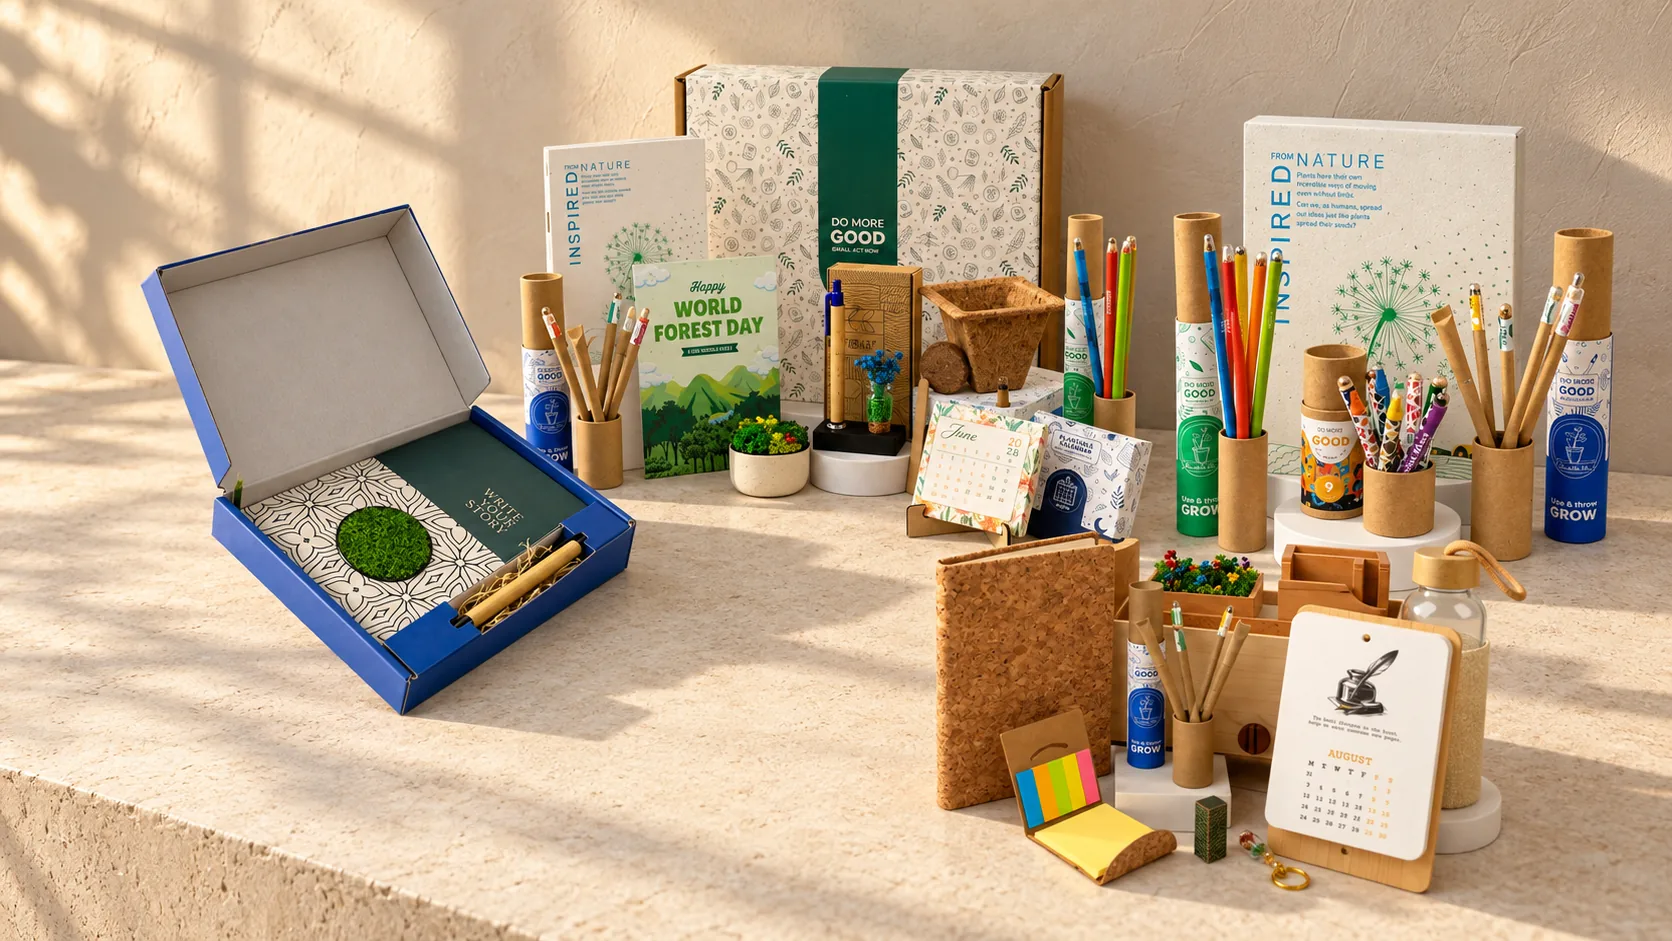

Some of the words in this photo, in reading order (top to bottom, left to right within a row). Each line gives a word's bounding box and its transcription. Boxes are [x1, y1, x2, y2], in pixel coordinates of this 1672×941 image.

[580, 160, 630, 172] NATURE
[1297, 152, 1384, 169] NATURE
[566, 172, 581, 266] INSPIRED
[832, 218, 848, 226] DO
[852, 218, 884, 228] MORE
[830, 230, 886, 244] GOOD
[690, 280, 726, 294] Happy
[674, 296, 742, 318] WORLD
[654, 320, 722, 342] FOREST
[726, 316, 764, 336] DAY
[1184, 389, 1216, 398] GOOD
[1560, 386, 1594, 396] GOOD
[940, 423, 977, 441] June
[1008, 438, 1022, 448] 20
[1312, 436, 1350, 446] GOOD
[1006, 448, 1019, 457] 28
[1324, 482, 1333, 492] 9
[484, 488, 524, 522] WRITE
[465, 500, 508, 533] STORY
[481, 498, 516, 528] YOUR
[1550, 506, 1597, 521] GROW
[1131, 744, 1161, 754] GROW
[1328, 749, 1372, 766] AUGUST
